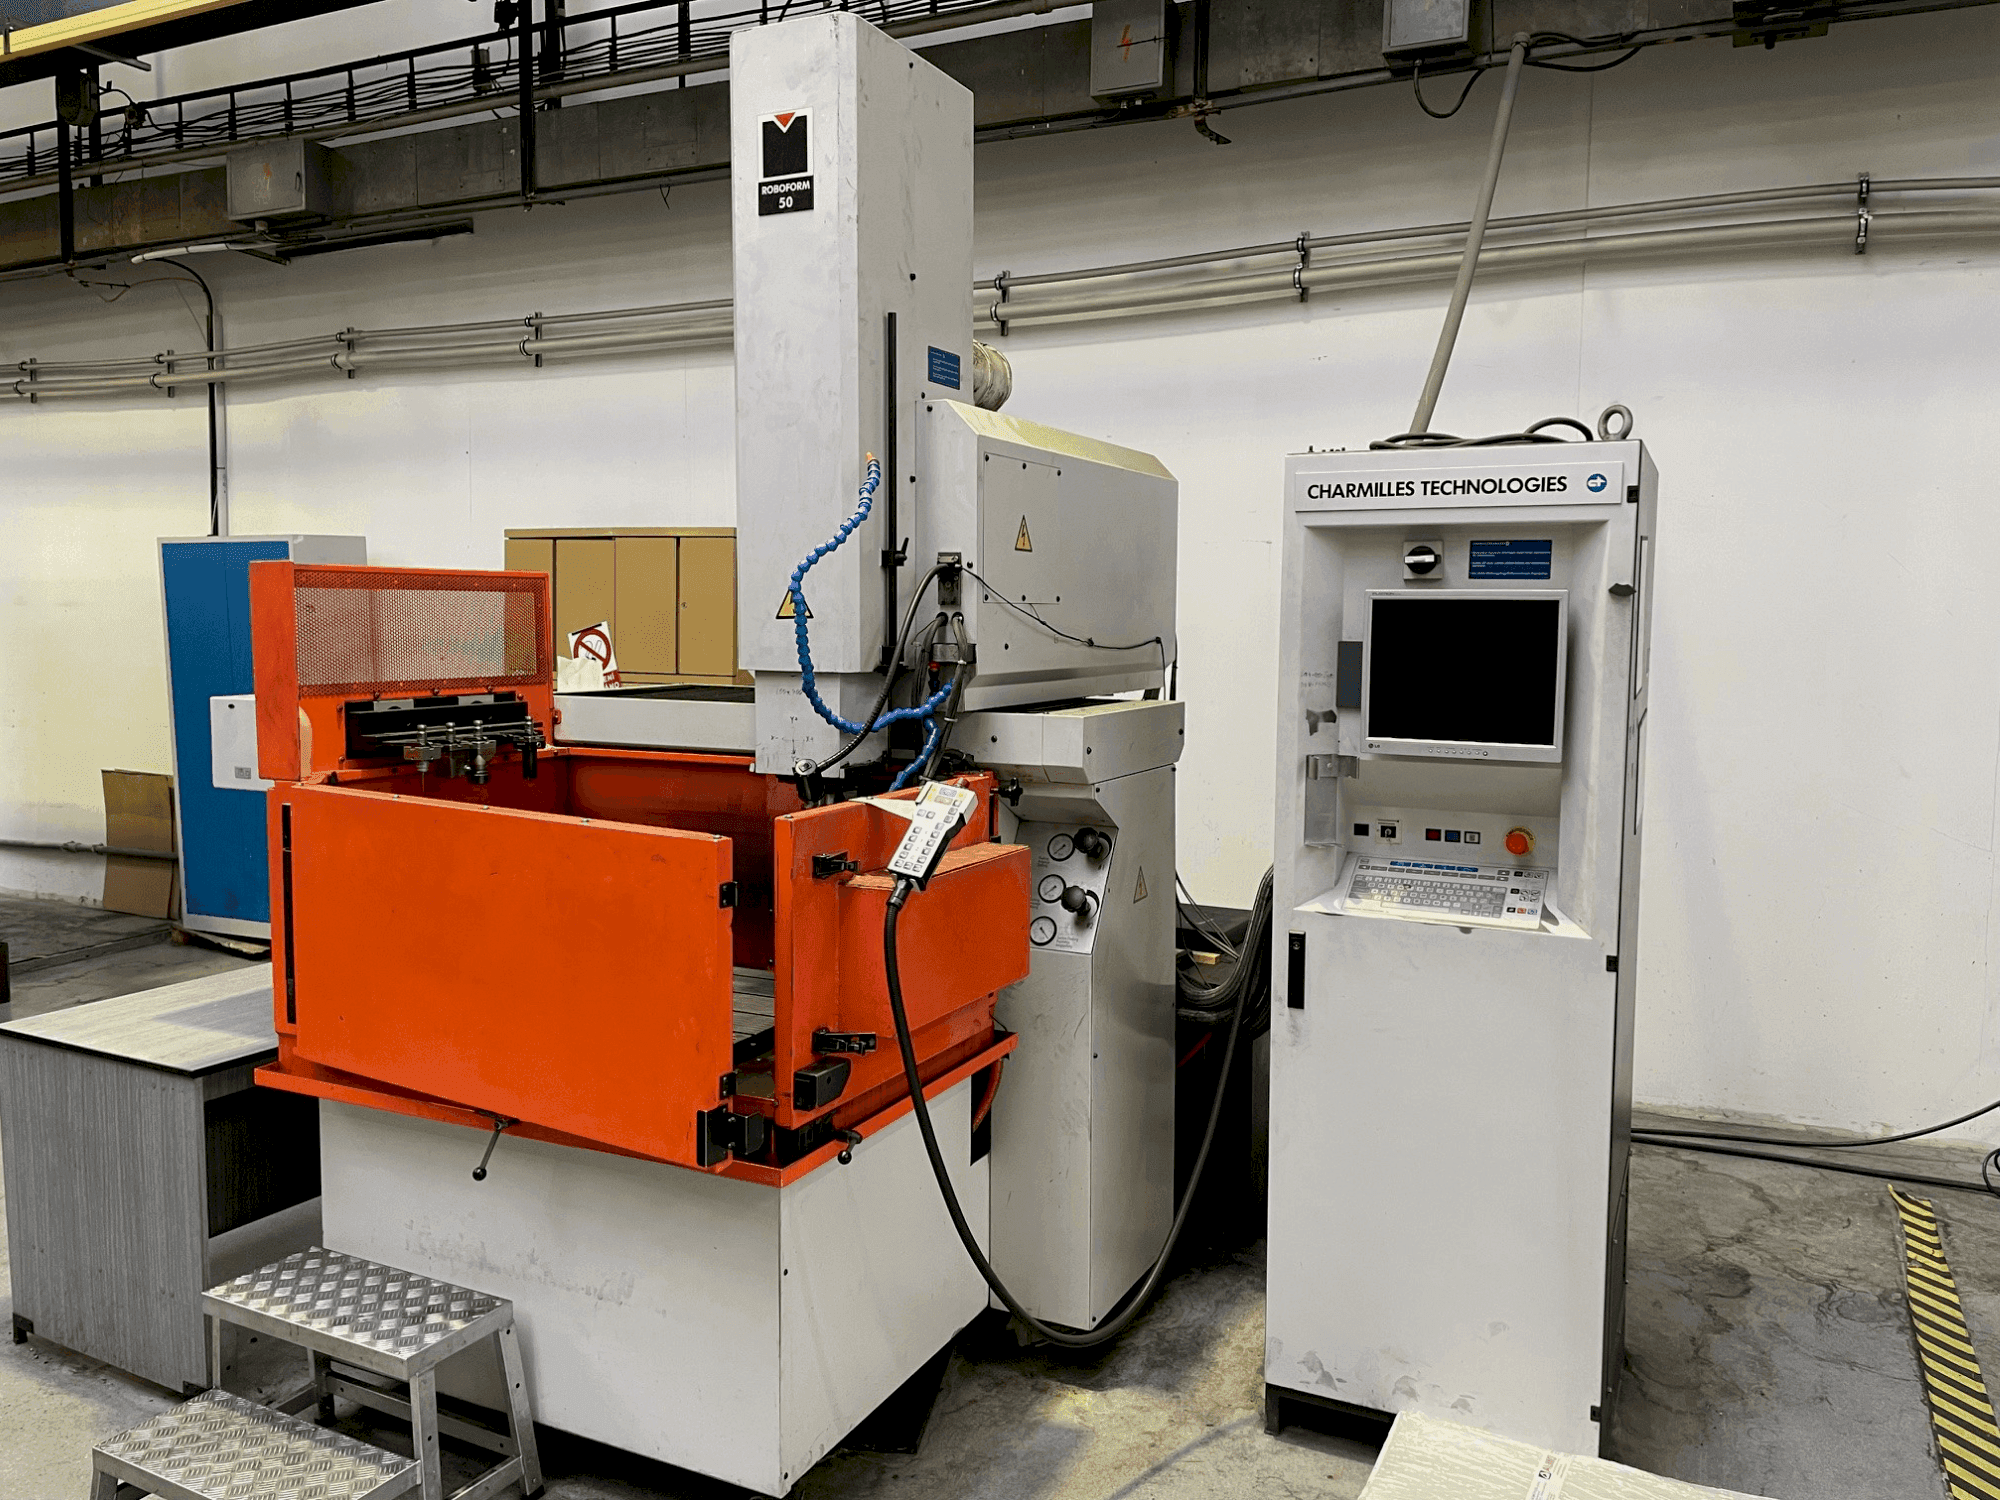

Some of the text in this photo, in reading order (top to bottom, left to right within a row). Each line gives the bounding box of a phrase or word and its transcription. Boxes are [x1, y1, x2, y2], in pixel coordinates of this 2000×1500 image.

[761, 180, 811, 195] ROBOFORM
[778, 196, 793, 209] 50
[1307, 475, 1568, 499] CHARMILLES TECHNOLOGIES
